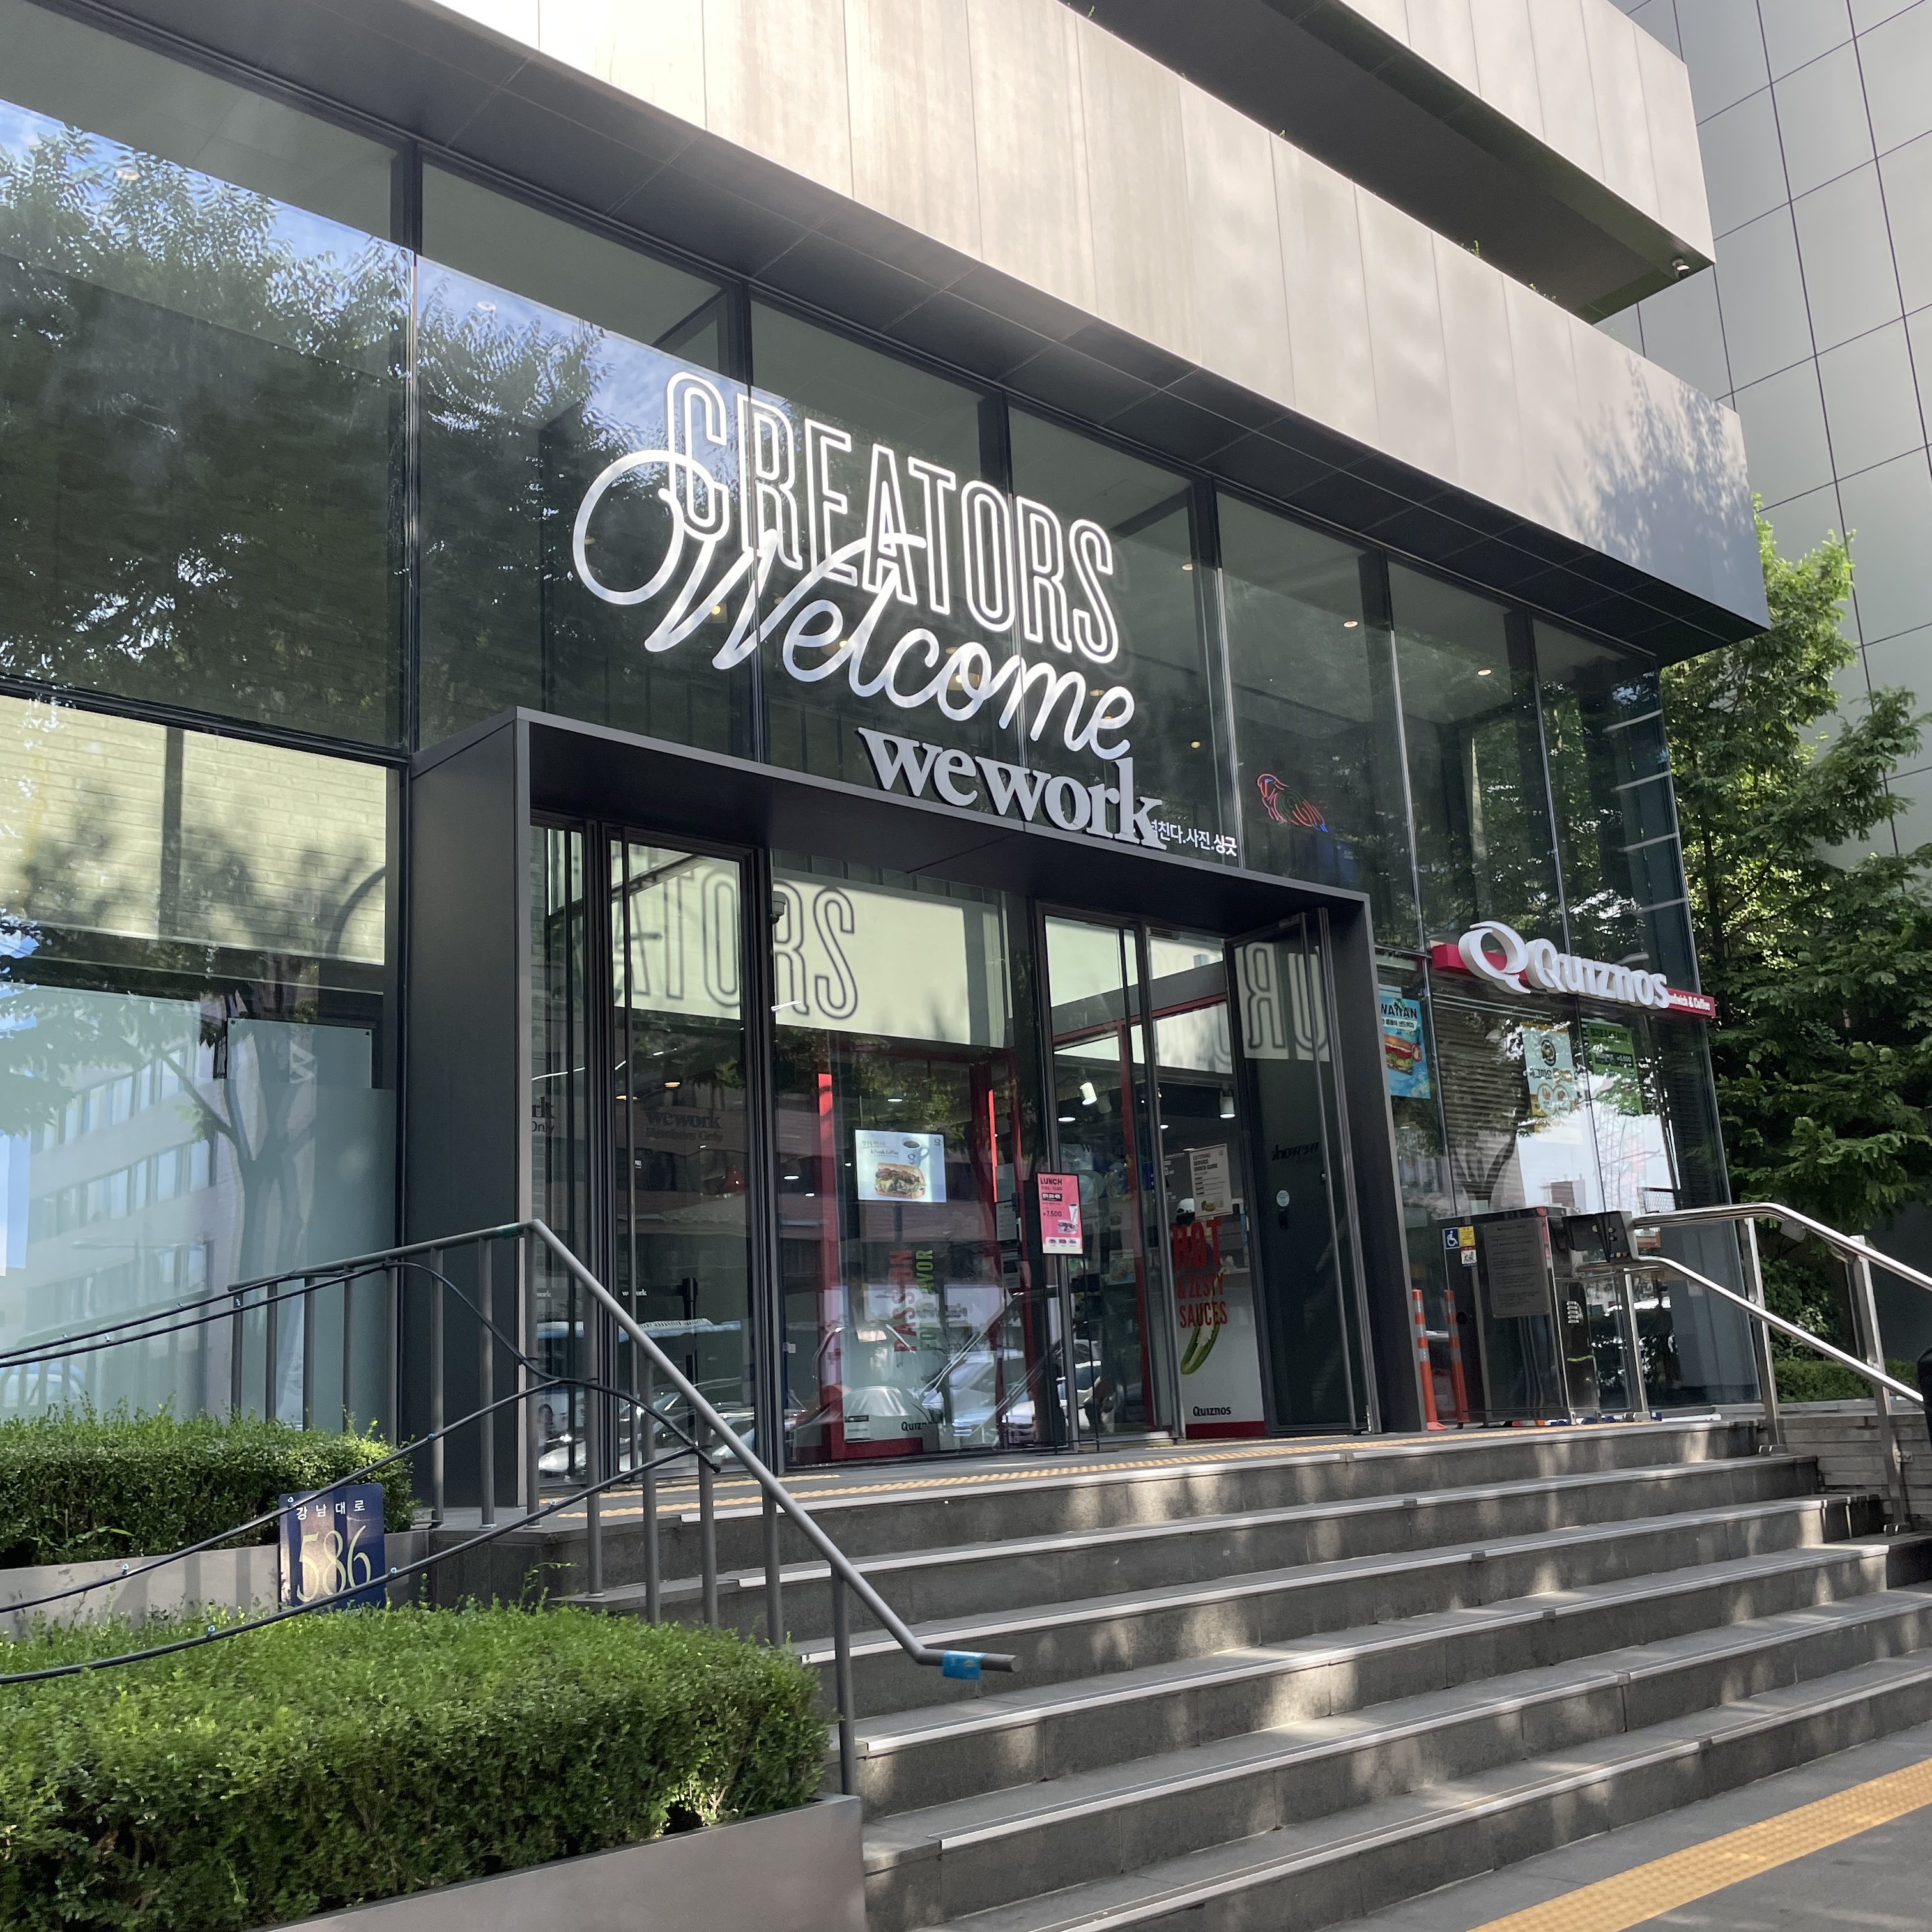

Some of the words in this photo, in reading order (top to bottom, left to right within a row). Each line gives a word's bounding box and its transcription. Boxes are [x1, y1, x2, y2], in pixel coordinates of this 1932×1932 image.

[666, 371, 1120, 664] CREATORS
[572, 449, 1136, 760] Welcome
[855, 727, 1167, 850] wework
[1040, 1177, 1062, 1186] LUNCH
[1172, 1218, 1222, 1271] HOT
[889, 1249, 918, 1352] PASSION
[1179, 1300, 1228, 1328] SAUCES
[901, 1421, 926, 1432] Quiz
[1193, 1406, 1232, 1416] Quiznos
[296, 1499, 365, 1521] 강남대로
[296, 1524, 371, 1602] 586
